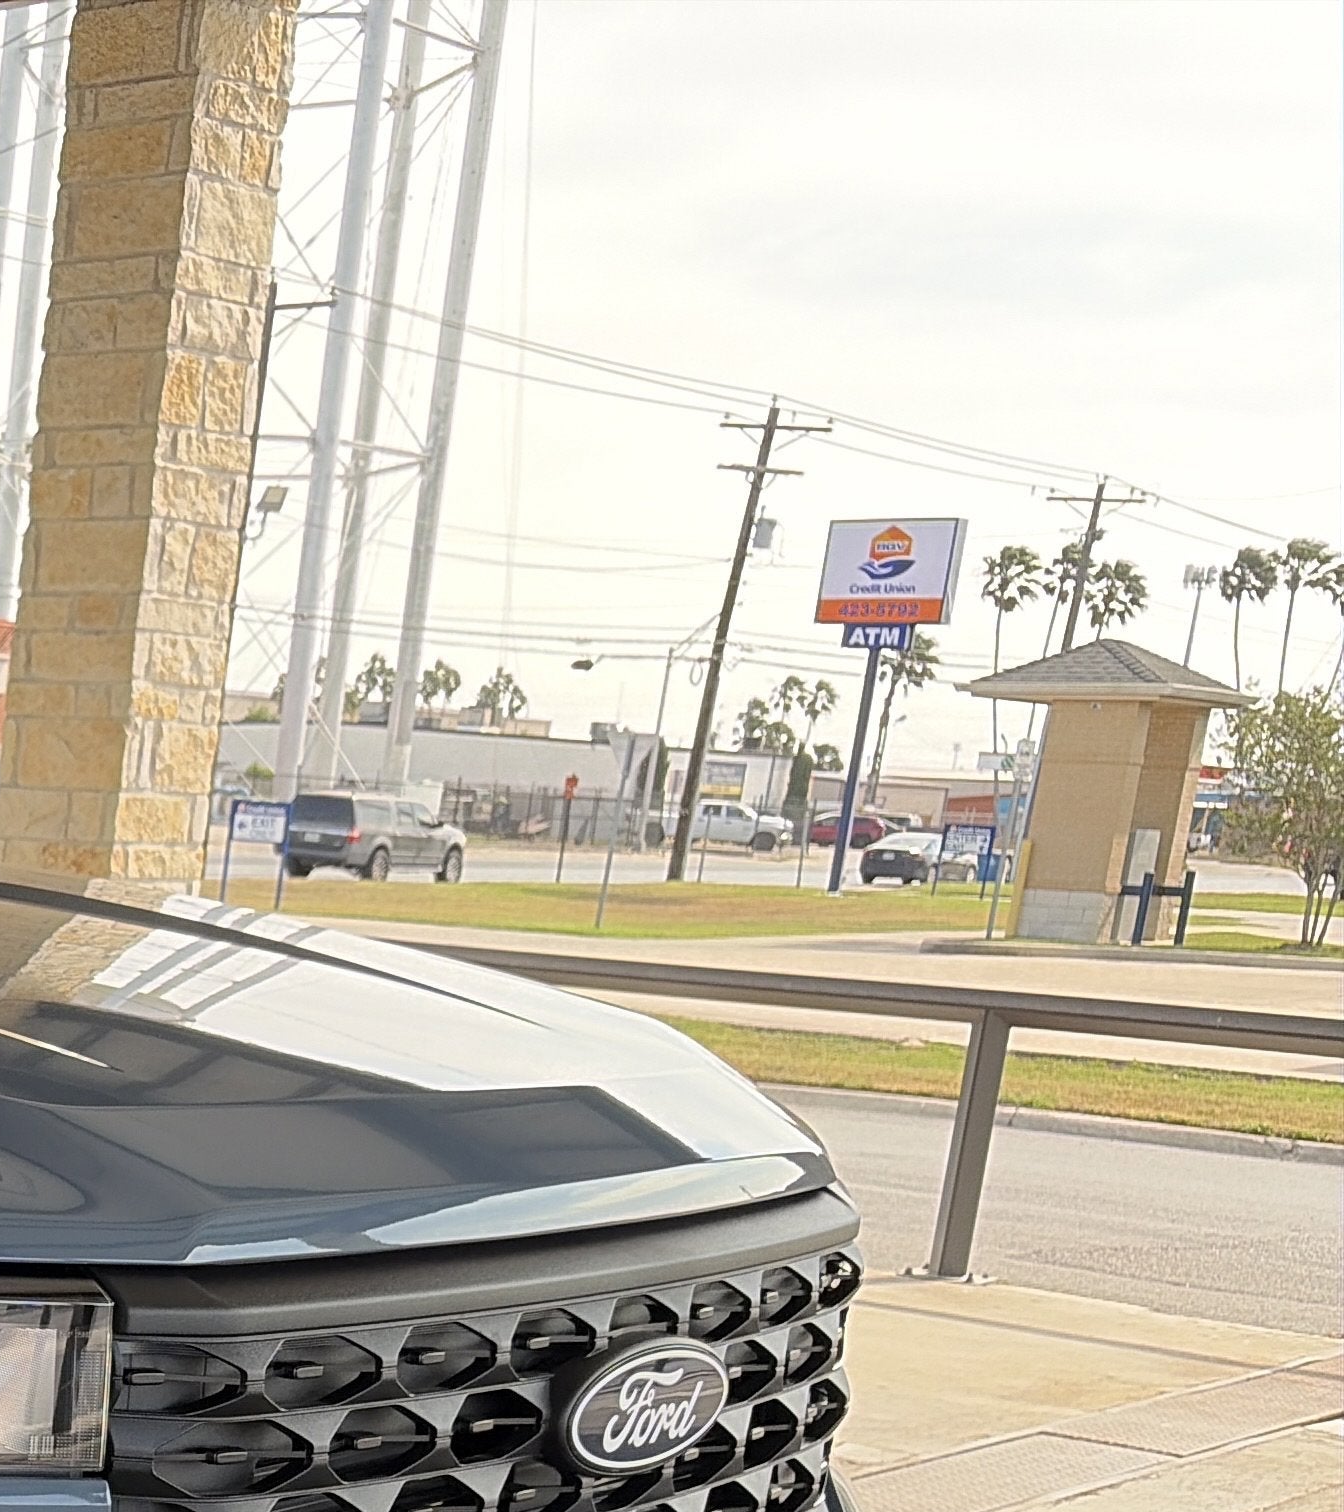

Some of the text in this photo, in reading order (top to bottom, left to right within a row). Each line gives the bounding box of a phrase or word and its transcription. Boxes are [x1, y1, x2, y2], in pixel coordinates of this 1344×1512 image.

[849, 582, 916, 594] Credit Union
[848, 626, 901, 647] ATM
[603, 1367, 704, 1453] Ford
